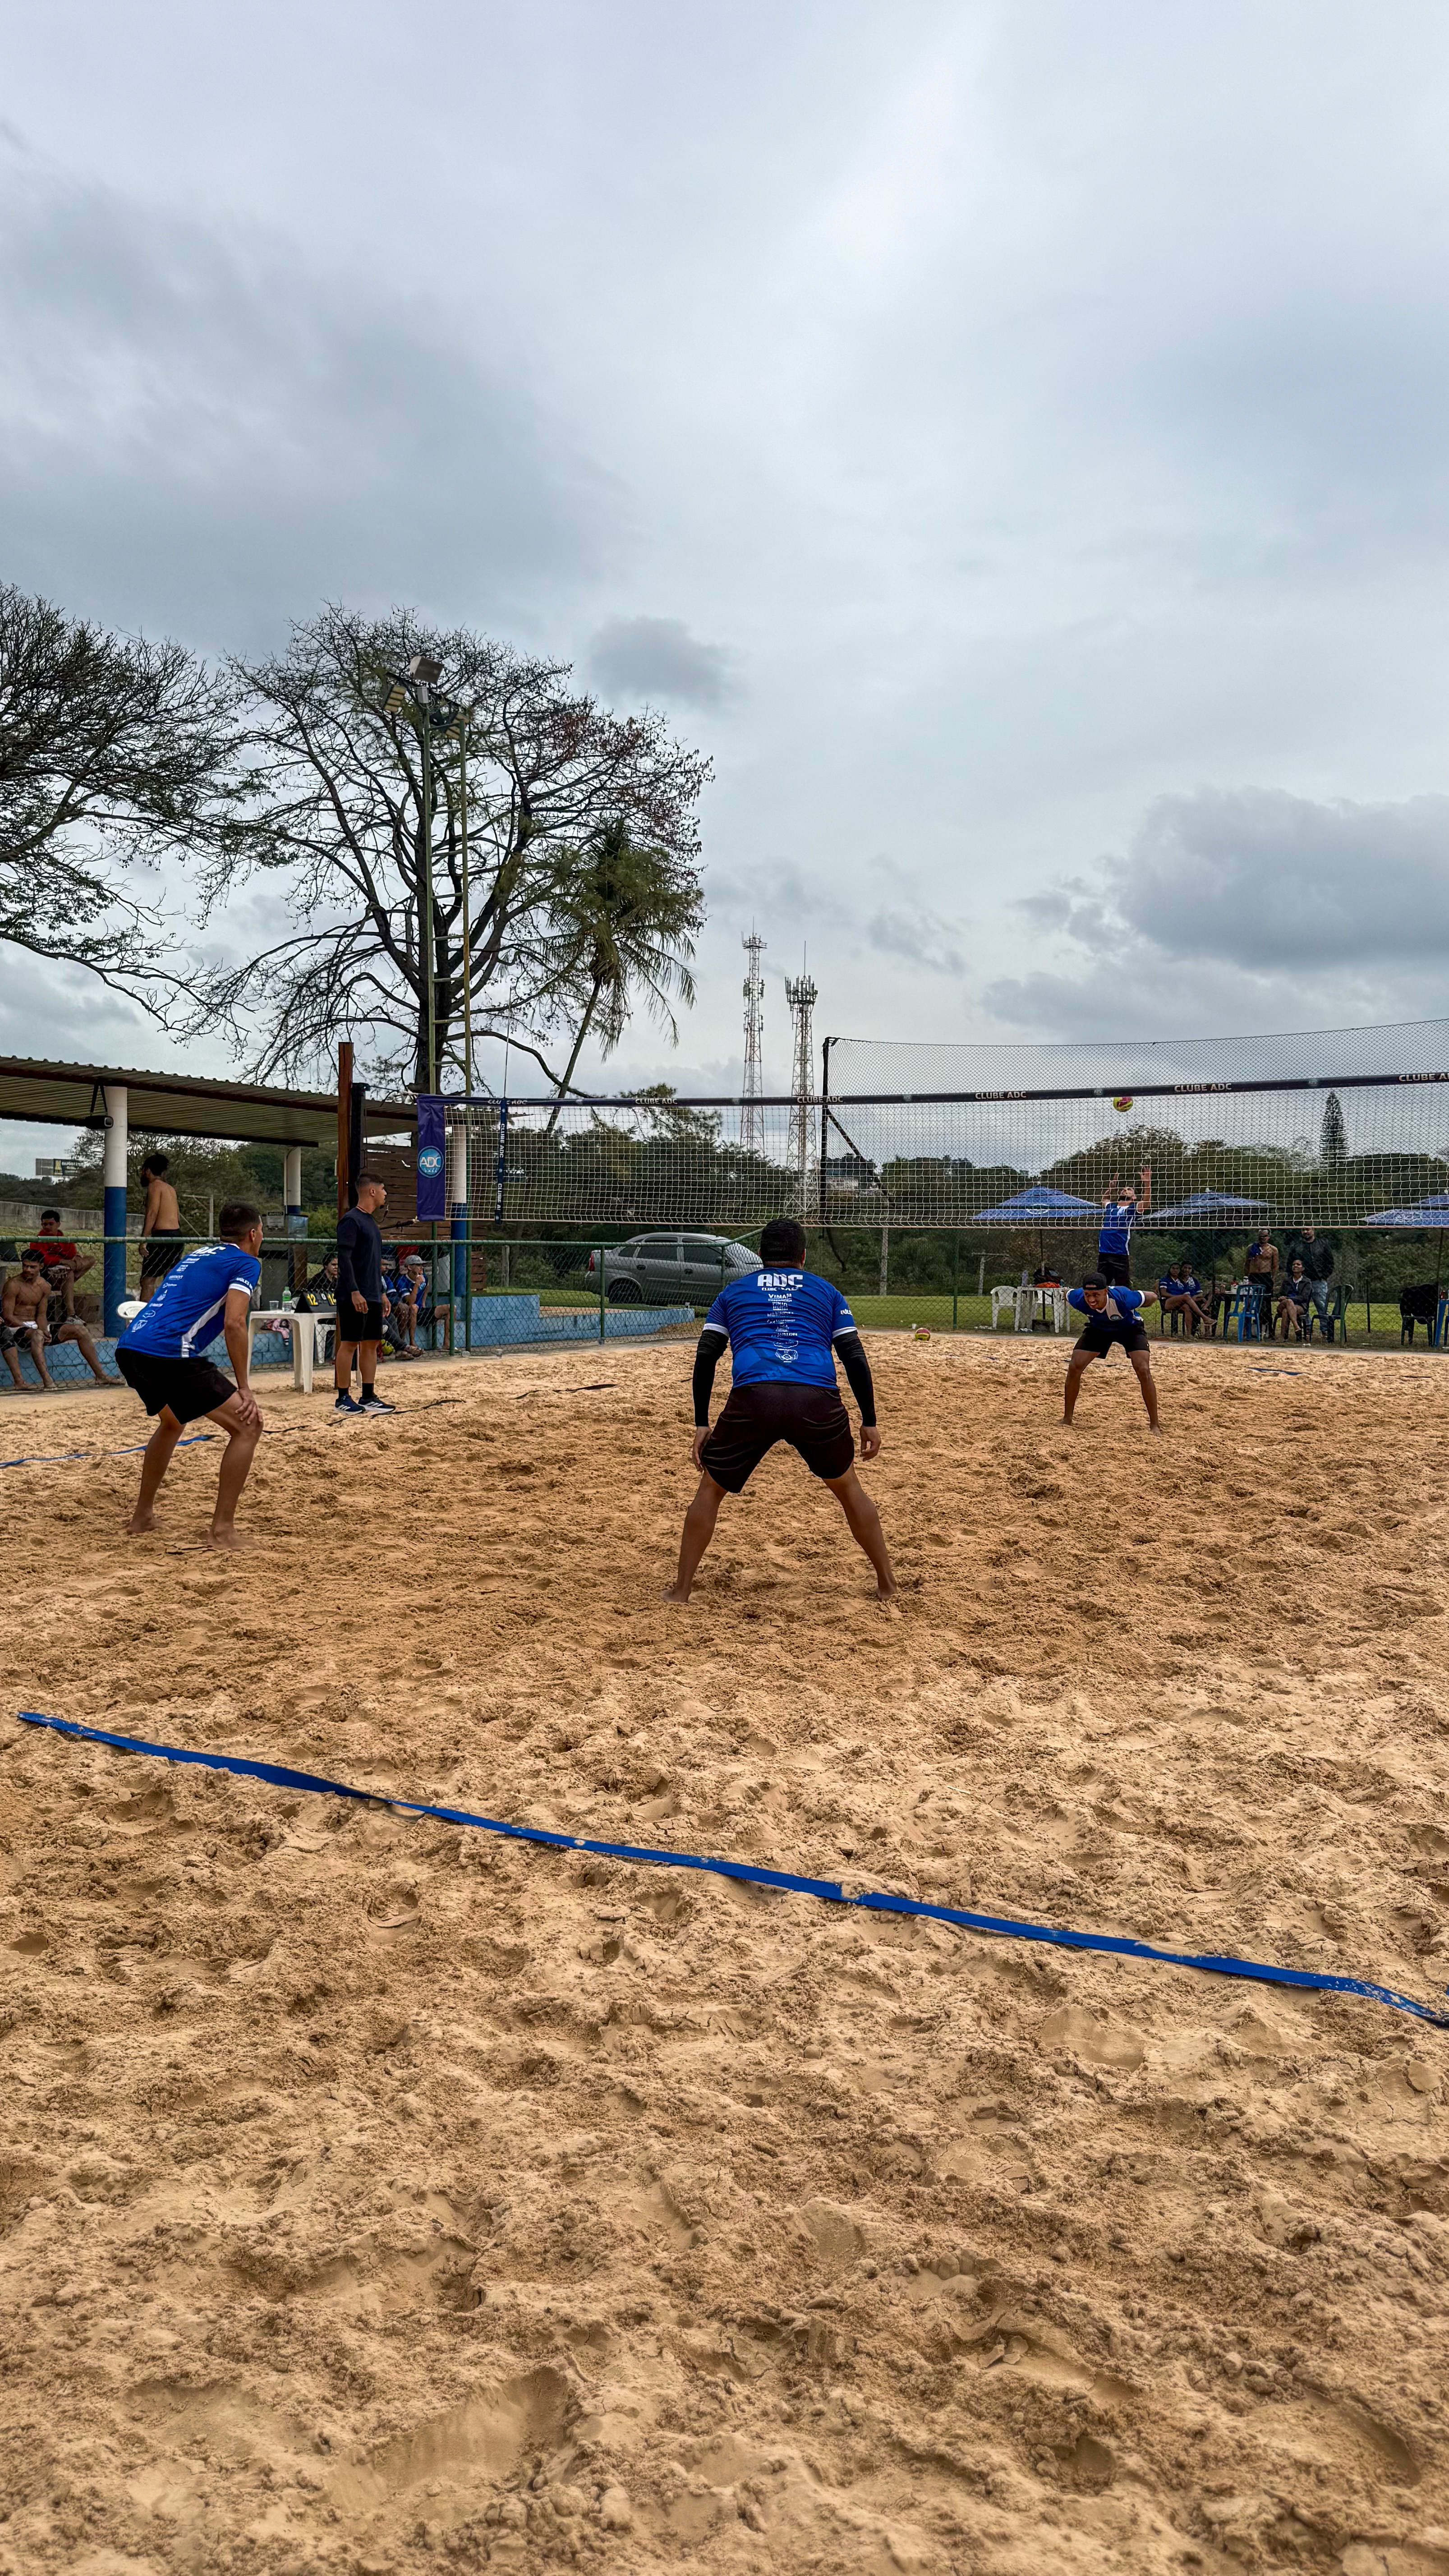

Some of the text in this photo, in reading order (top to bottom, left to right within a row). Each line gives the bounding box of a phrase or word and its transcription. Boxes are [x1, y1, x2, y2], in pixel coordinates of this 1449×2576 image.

[1398, 1073, 1435, 1081] CLUBE
[1174, 1083, 1232, 1092] CLUBE ADC
[419, 1156, 441, 1168] ADC
[757, 1273, 803, 1288] ADC
[307, 1293, 318, 1306] 12
